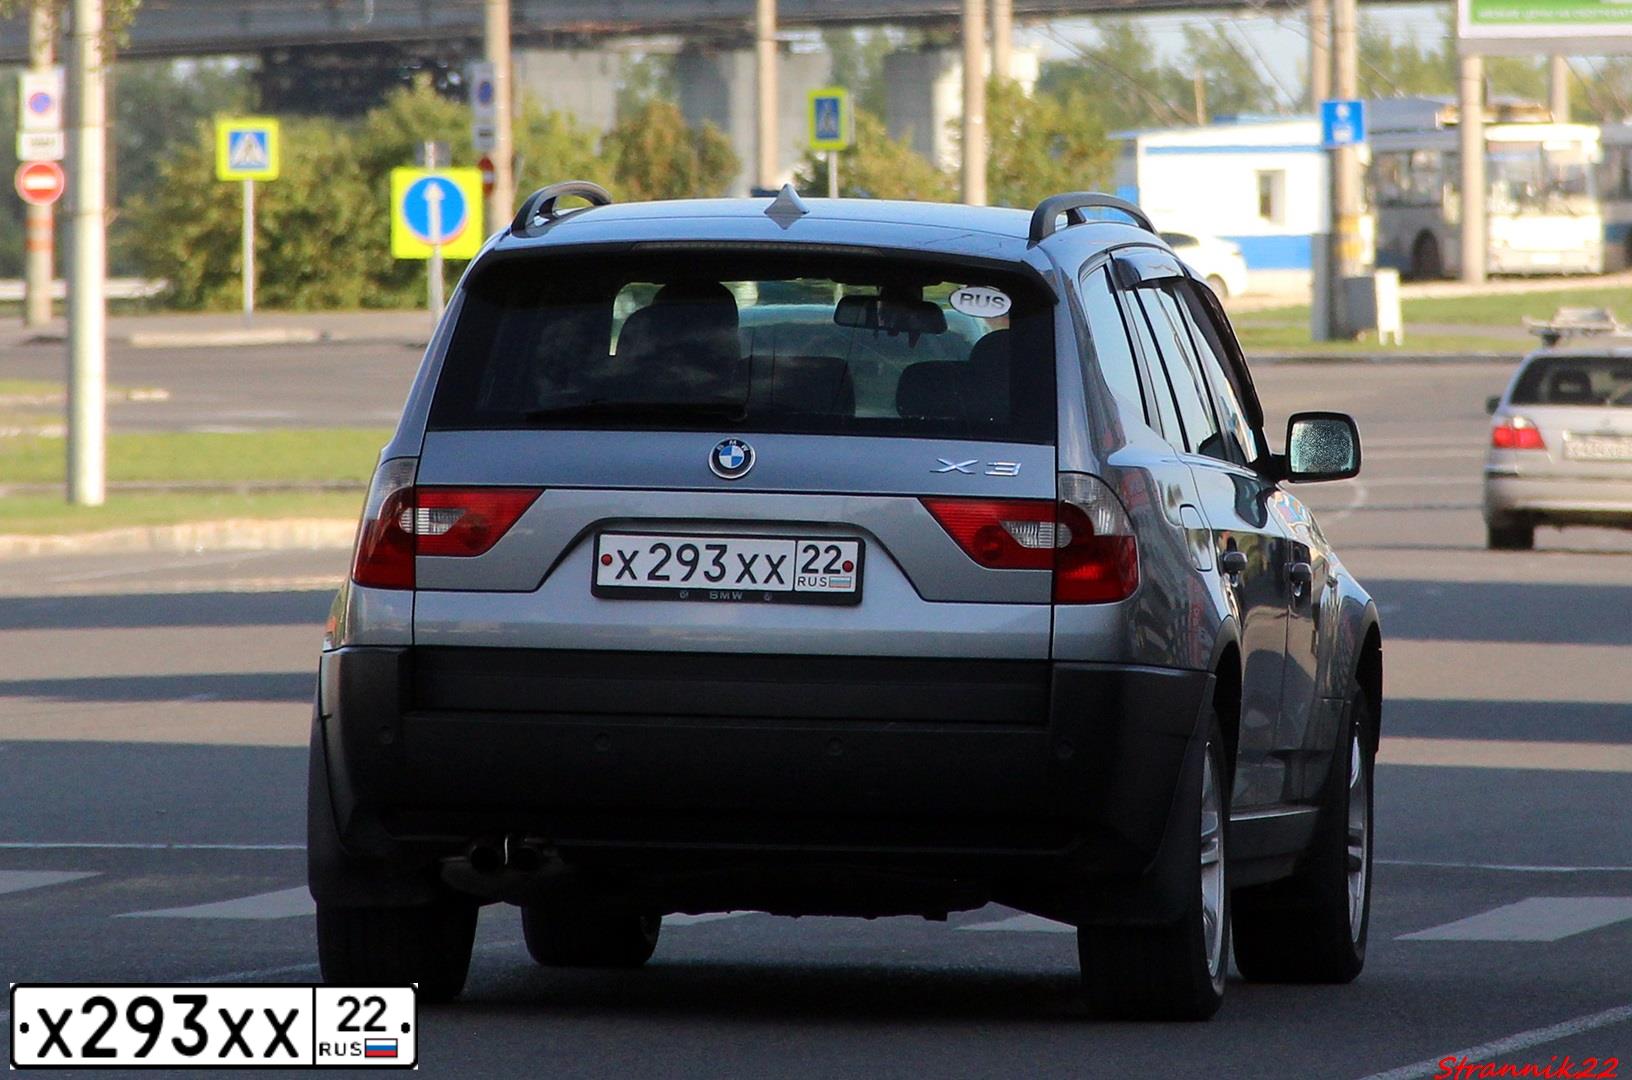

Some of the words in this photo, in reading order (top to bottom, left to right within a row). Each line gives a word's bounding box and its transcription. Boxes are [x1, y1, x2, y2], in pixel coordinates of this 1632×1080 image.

[960, 292, 1004, 310] RUS
[716, 440, 749, 452] BMW
[801, 545, 842, 574] 22
[797, 576, 828, 587] RUS
[709, 591, 743, 600] BMW
